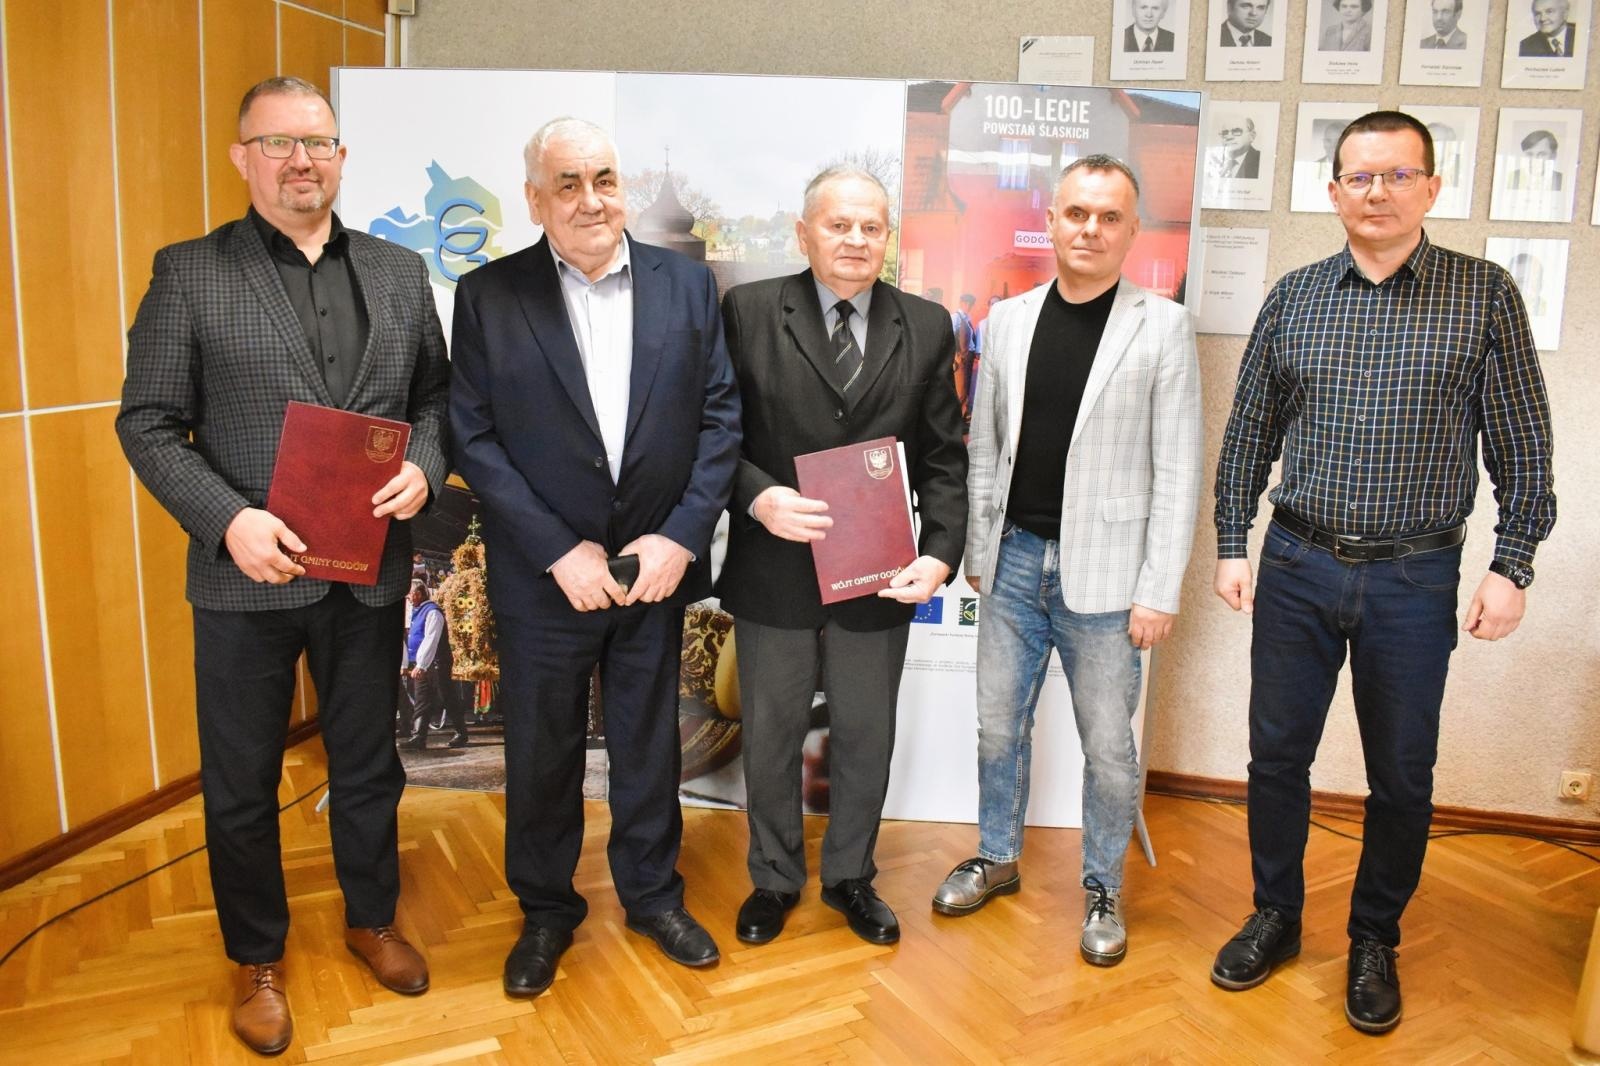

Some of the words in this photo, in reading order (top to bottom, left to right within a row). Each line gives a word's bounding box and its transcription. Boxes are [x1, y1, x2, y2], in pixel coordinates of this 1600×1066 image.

[984, 94, 1091, 123] 100-LECIE
[983, 121, 1036, 136] POWSTAŃ
[1039, 122, 1090, 139] ŚLĄSKICH
[301, 555, 331, 567] GMINY
[332, 560, 369, 572] GODÓW
[831, 579, 853, 591] WÓJT
[854, 573, 879, 585] GMINY
[880, 566, 904, 580] GODÓ
